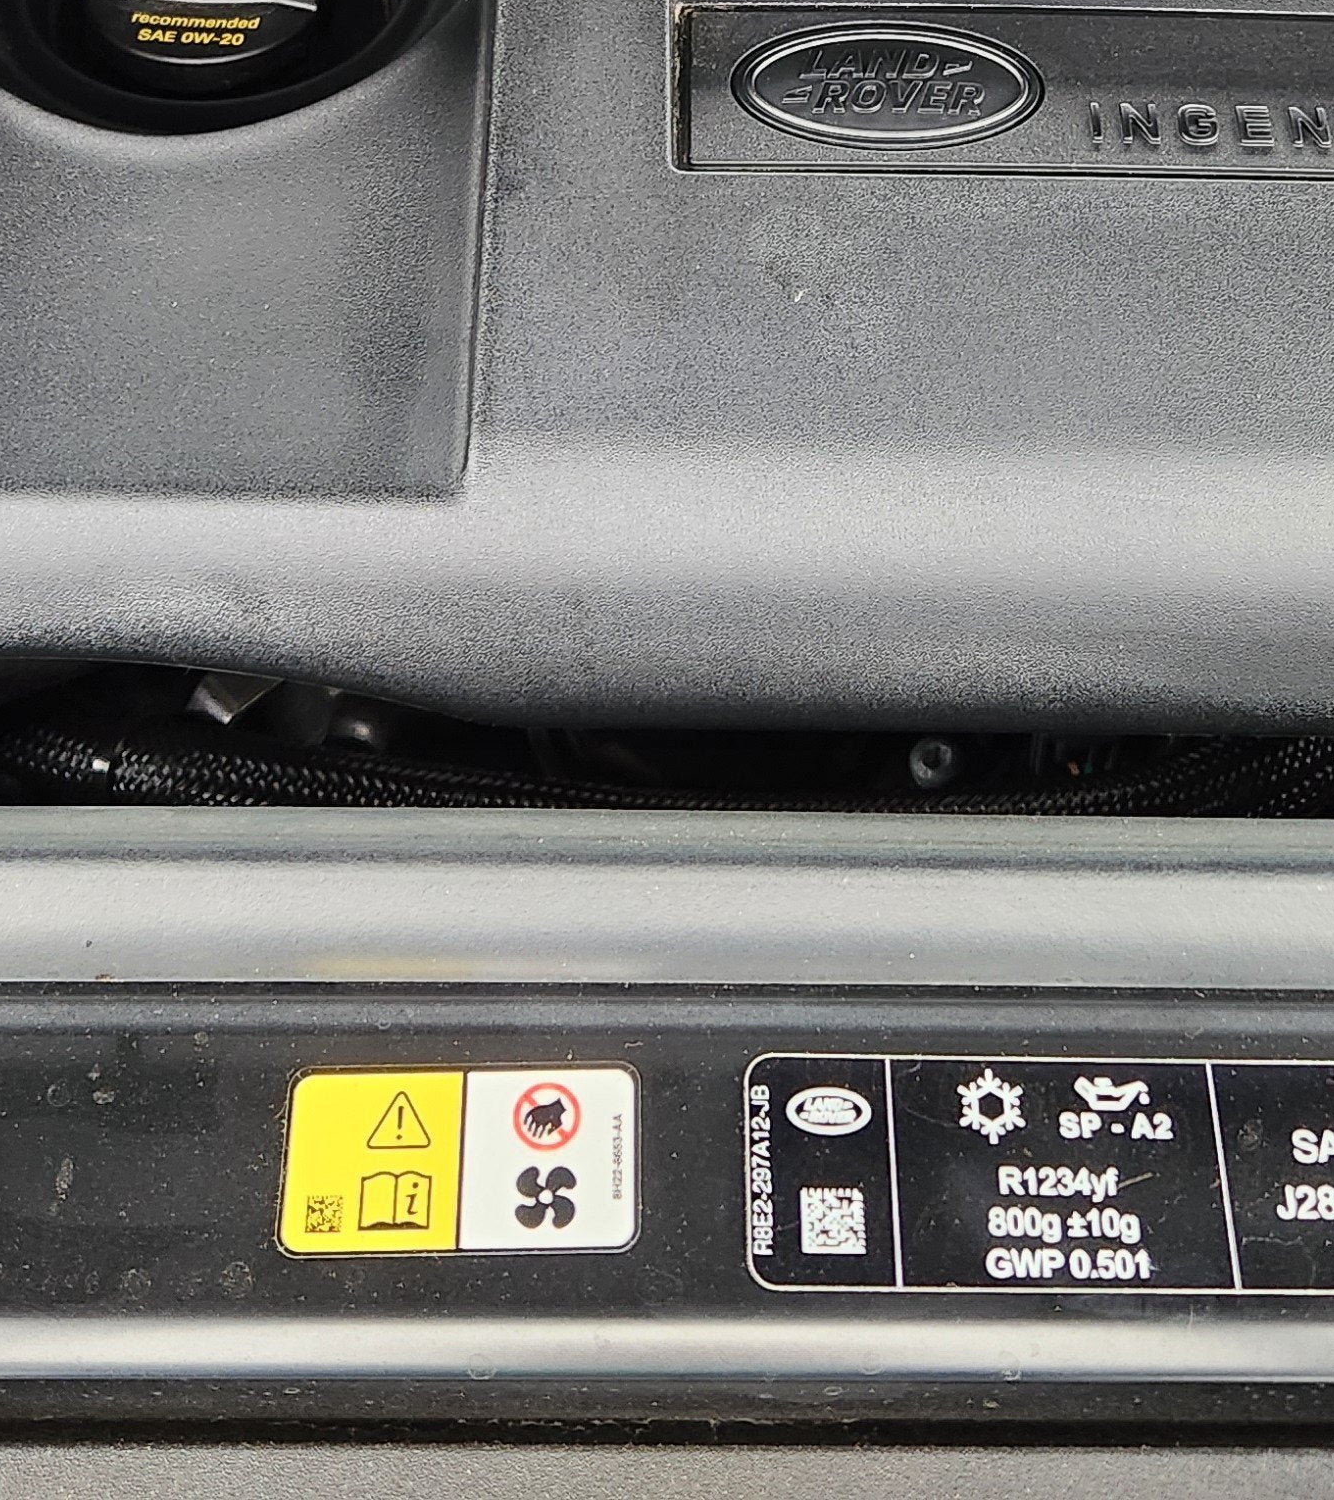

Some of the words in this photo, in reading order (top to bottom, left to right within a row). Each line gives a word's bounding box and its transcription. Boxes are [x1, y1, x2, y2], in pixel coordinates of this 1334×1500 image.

[130, 11, 261, 30] recommended
[136, 28, 178, 43] SAE
[180, 31, 245, 46] 0W-20
[799, 49, 940, 80] LAND
[811, 79, 985, 116] ROVER
[998, 1165, 1120, 1200] R1234yf
[988, 1206, 1063, 1244] 800g
[1066, 1207, 1142, 1245] ±10g
[986, 1247, 1066, 1279] GWP
[1069, 1248, 1153, 1280] 0.501
